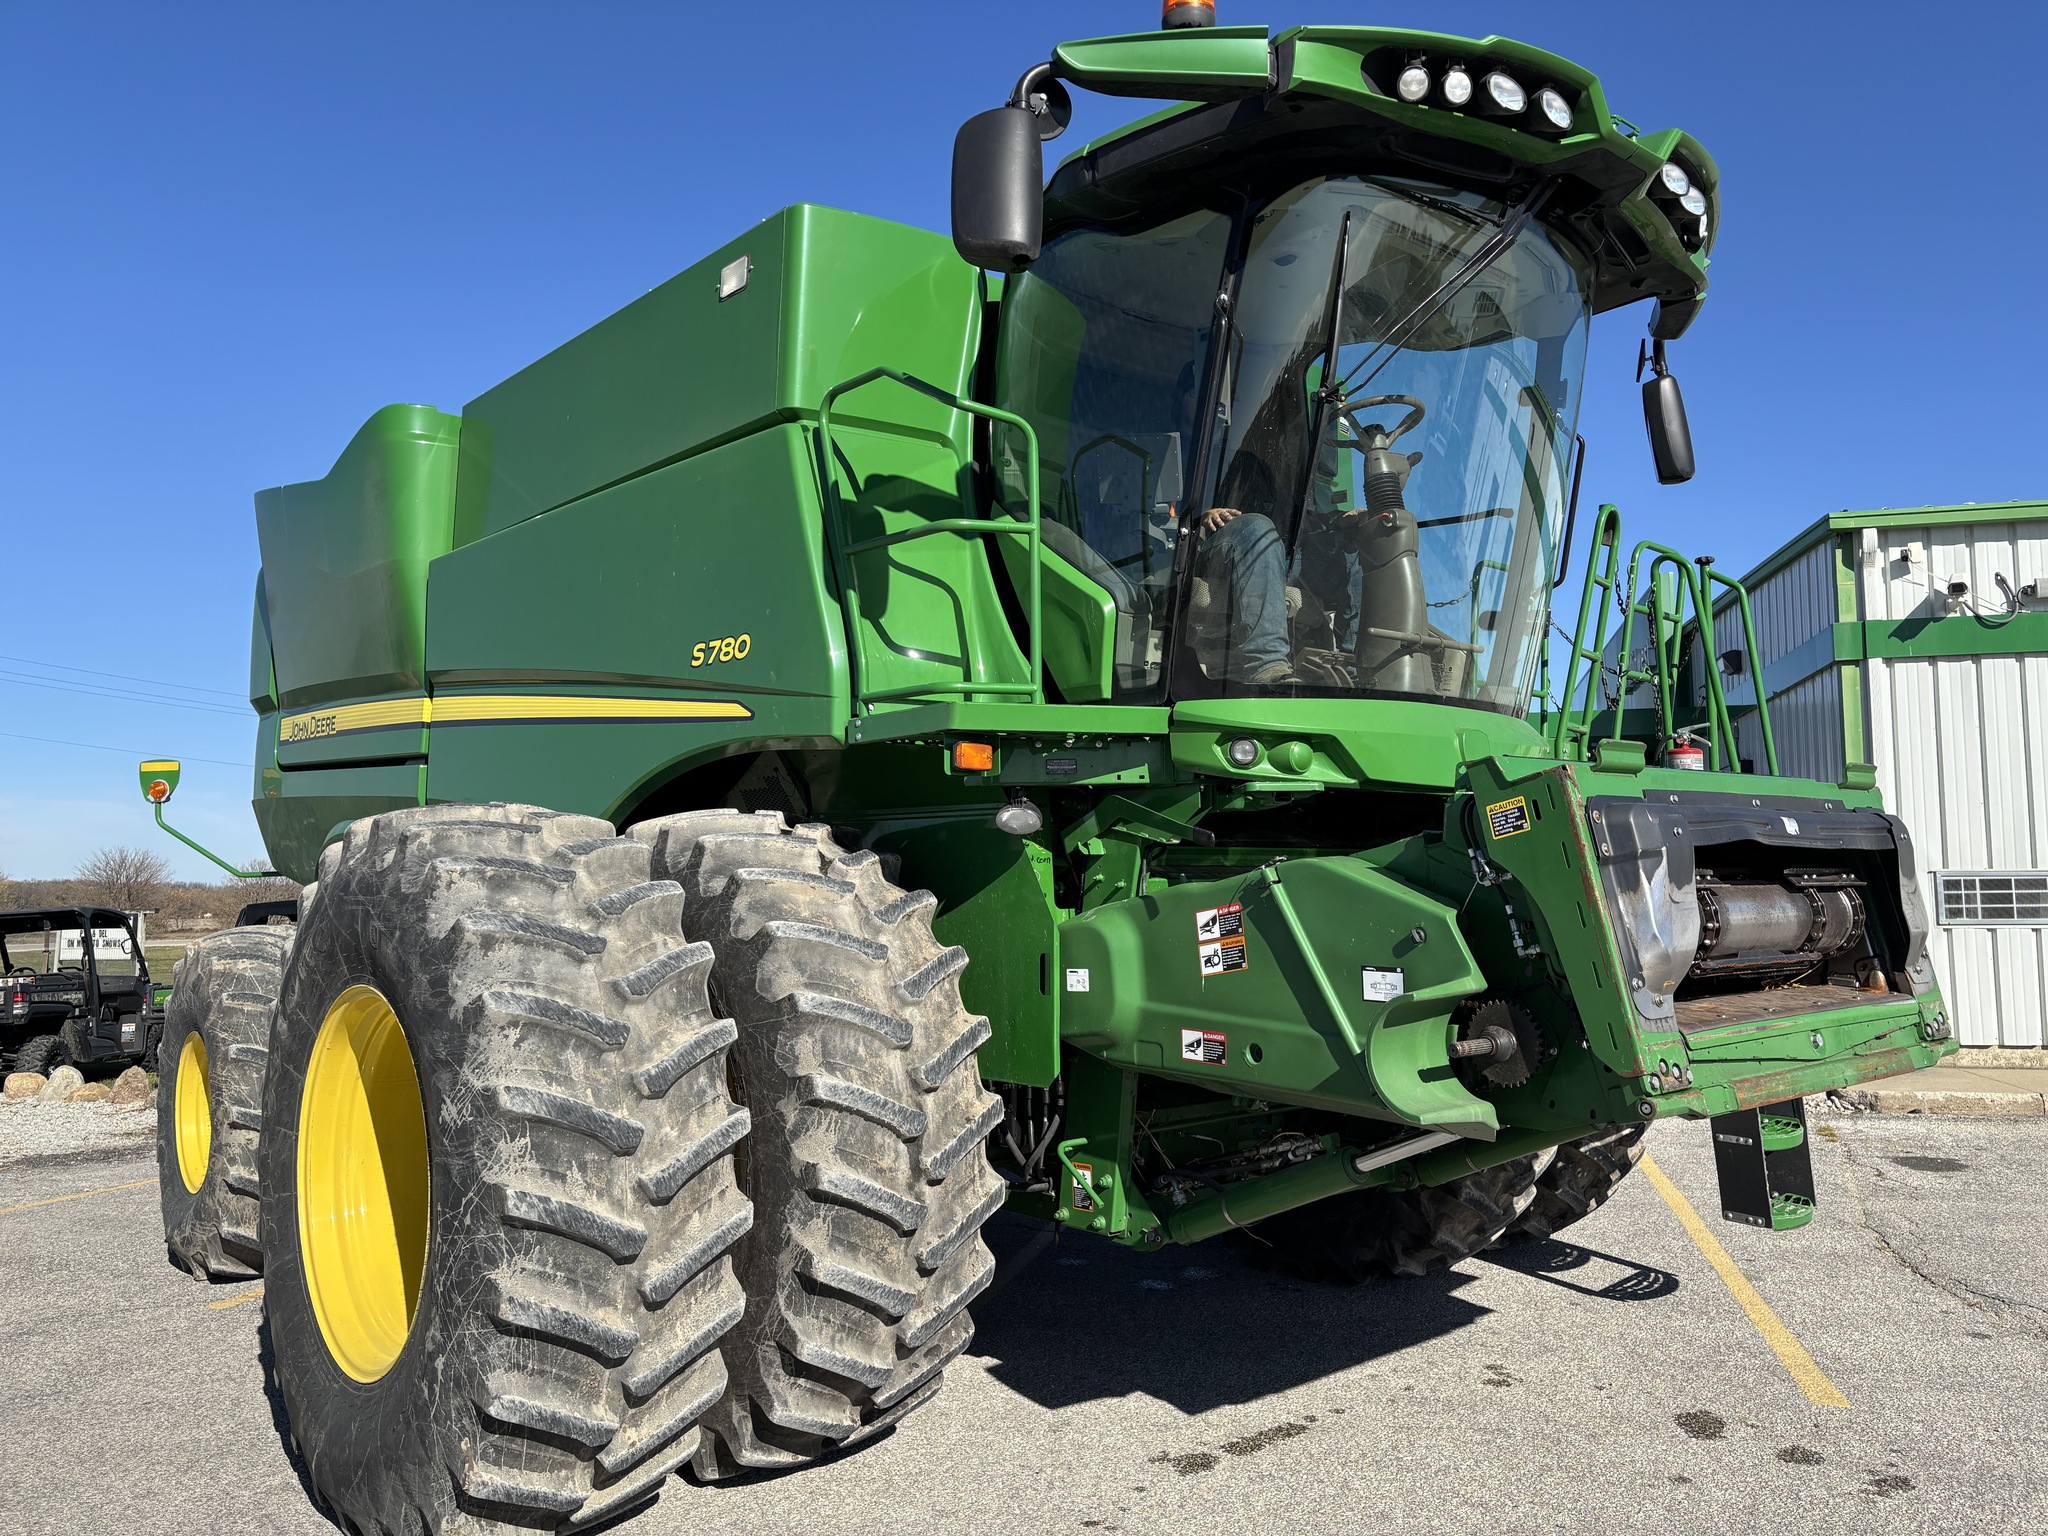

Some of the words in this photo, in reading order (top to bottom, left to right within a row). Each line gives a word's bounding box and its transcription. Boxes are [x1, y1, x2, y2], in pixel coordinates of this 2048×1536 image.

[690, 632, 751, 668] S780
[289, 720, 310, 740] JOHN
[310, 715, 337, 736] DEERE
[1494, 798, 1523, 811] CAUTION
